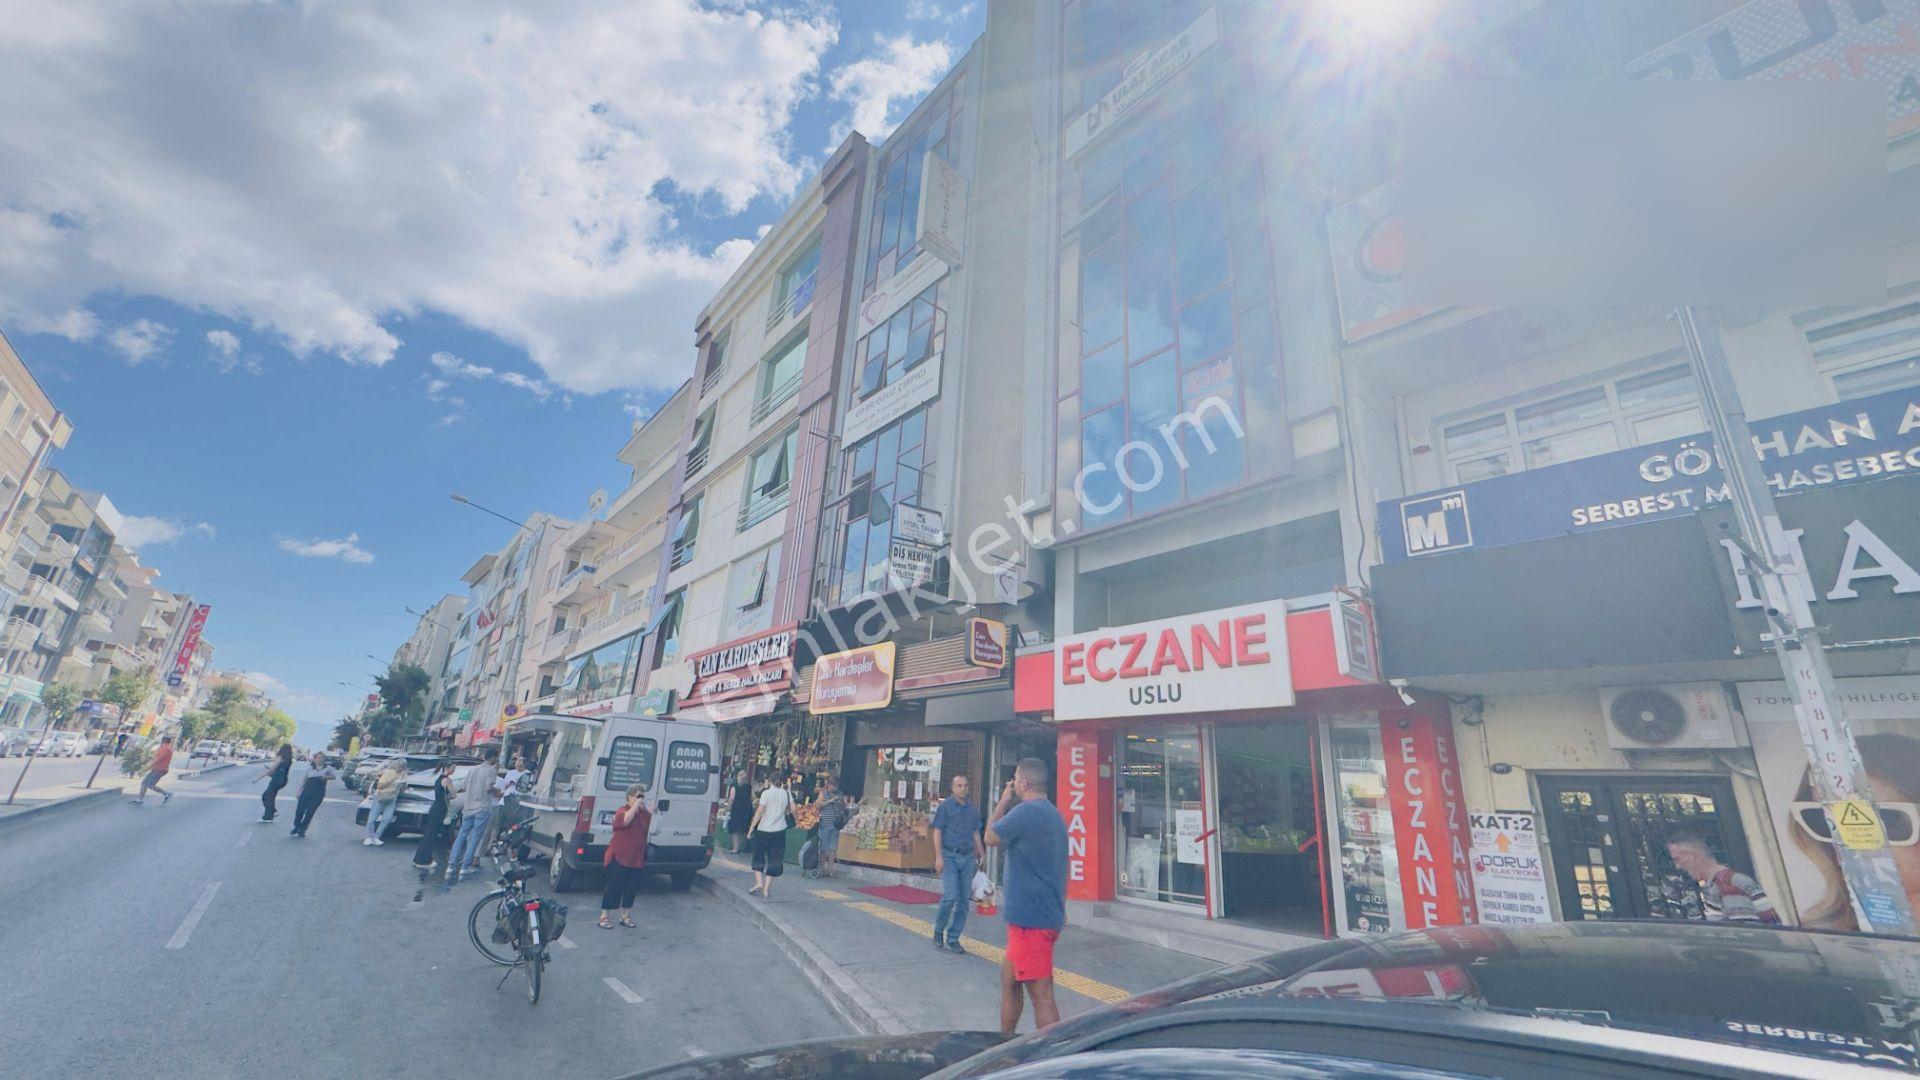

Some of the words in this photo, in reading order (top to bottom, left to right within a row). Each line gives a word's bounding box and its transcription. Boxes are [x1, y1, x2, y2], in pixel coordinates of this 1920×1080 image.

[1638, 412, 1876, 482] GÖHAN
[1571, 488, 1694, 526] SERBEST
[1705, 446, 1920, 504] MHASEBEC
[699, 652, 719, 677] CAN
[717, 632, 789, 672] KARDEŞLER
[1061, 613, 1270, 685] ECZANE
[1129, 682, 1183, 707] USLU
[1753, 695, 1793, 705] TOM
[671, 760, 707, 771] LOKMA
[676, 748, 704, 758] ARDA
[1067, 746, 1088, 882] ECZANE
[1401, 736, 1438, 929] ECZANE
[1437, 736, 1473, 925] ECZANE
[1470, 815, 1533, 831] KAT:2
[1480, 855, 1540, 870] DORUK
